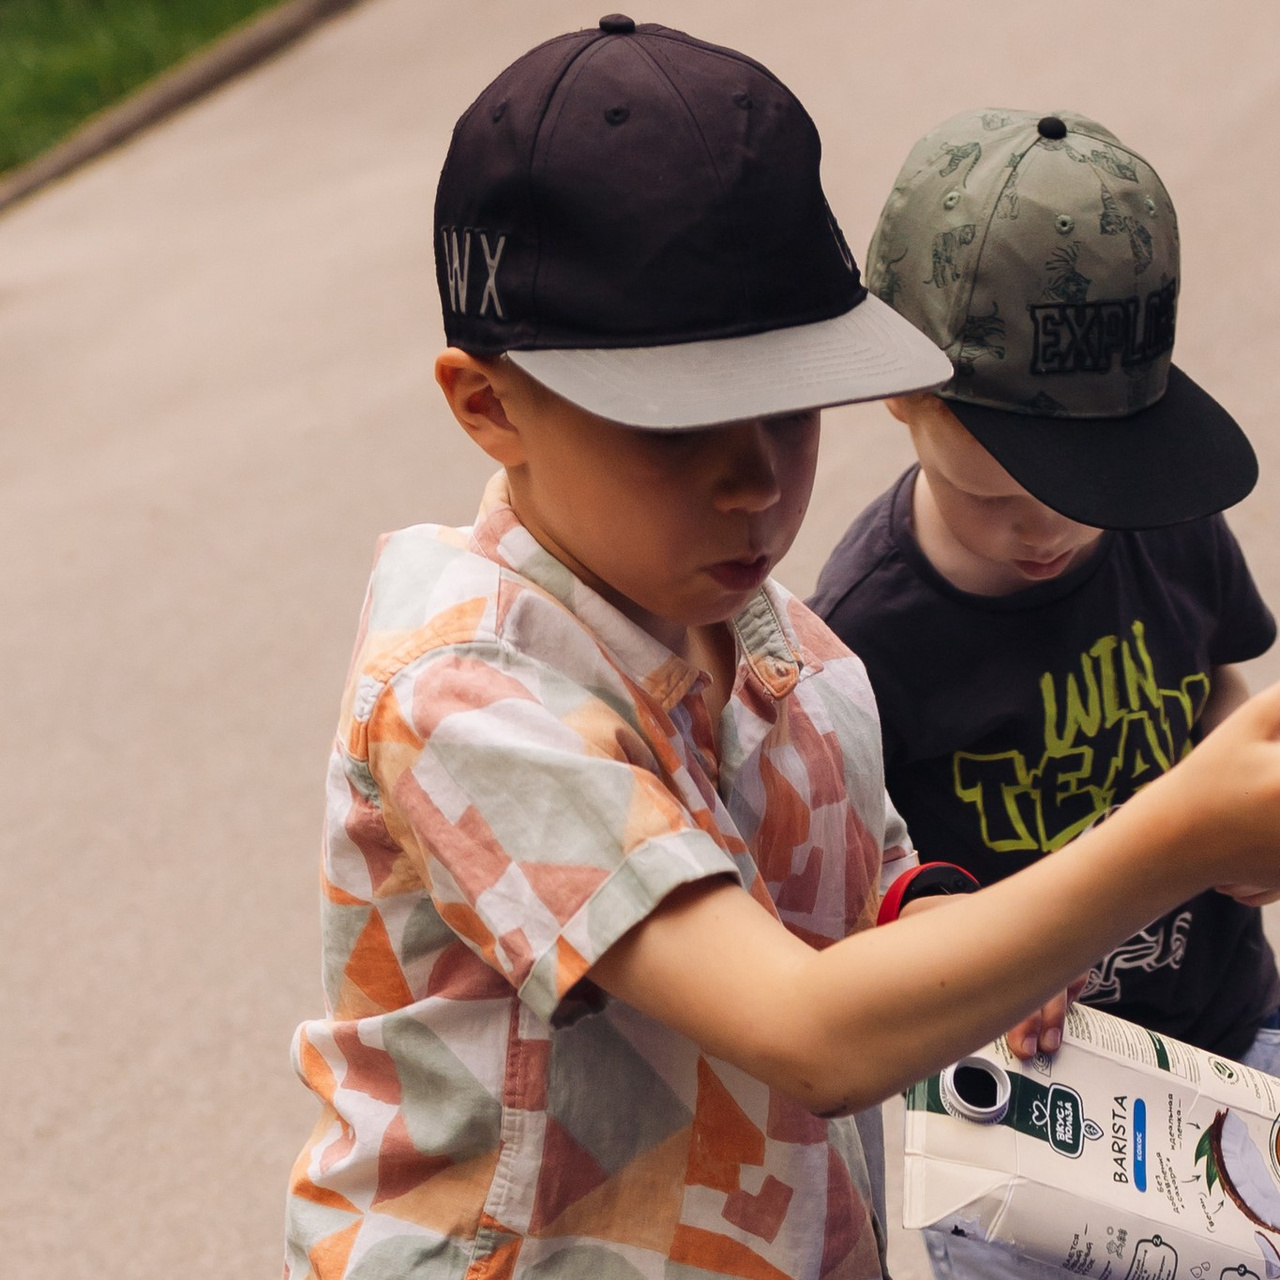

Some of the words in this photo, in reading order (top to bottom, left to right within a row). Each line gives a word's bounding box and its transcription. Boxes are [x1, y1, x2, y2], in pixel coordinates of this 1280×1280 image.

[441, 227, 507, 318] WX
[1040, 620, 1161, 749] WIN
[1056, 1107, 1065, 1141] ВКУС
[1065, 1102, 1074, 1144] ПОЛЬЗА
[1111, 1095, 1129, 1184] BARISTA
